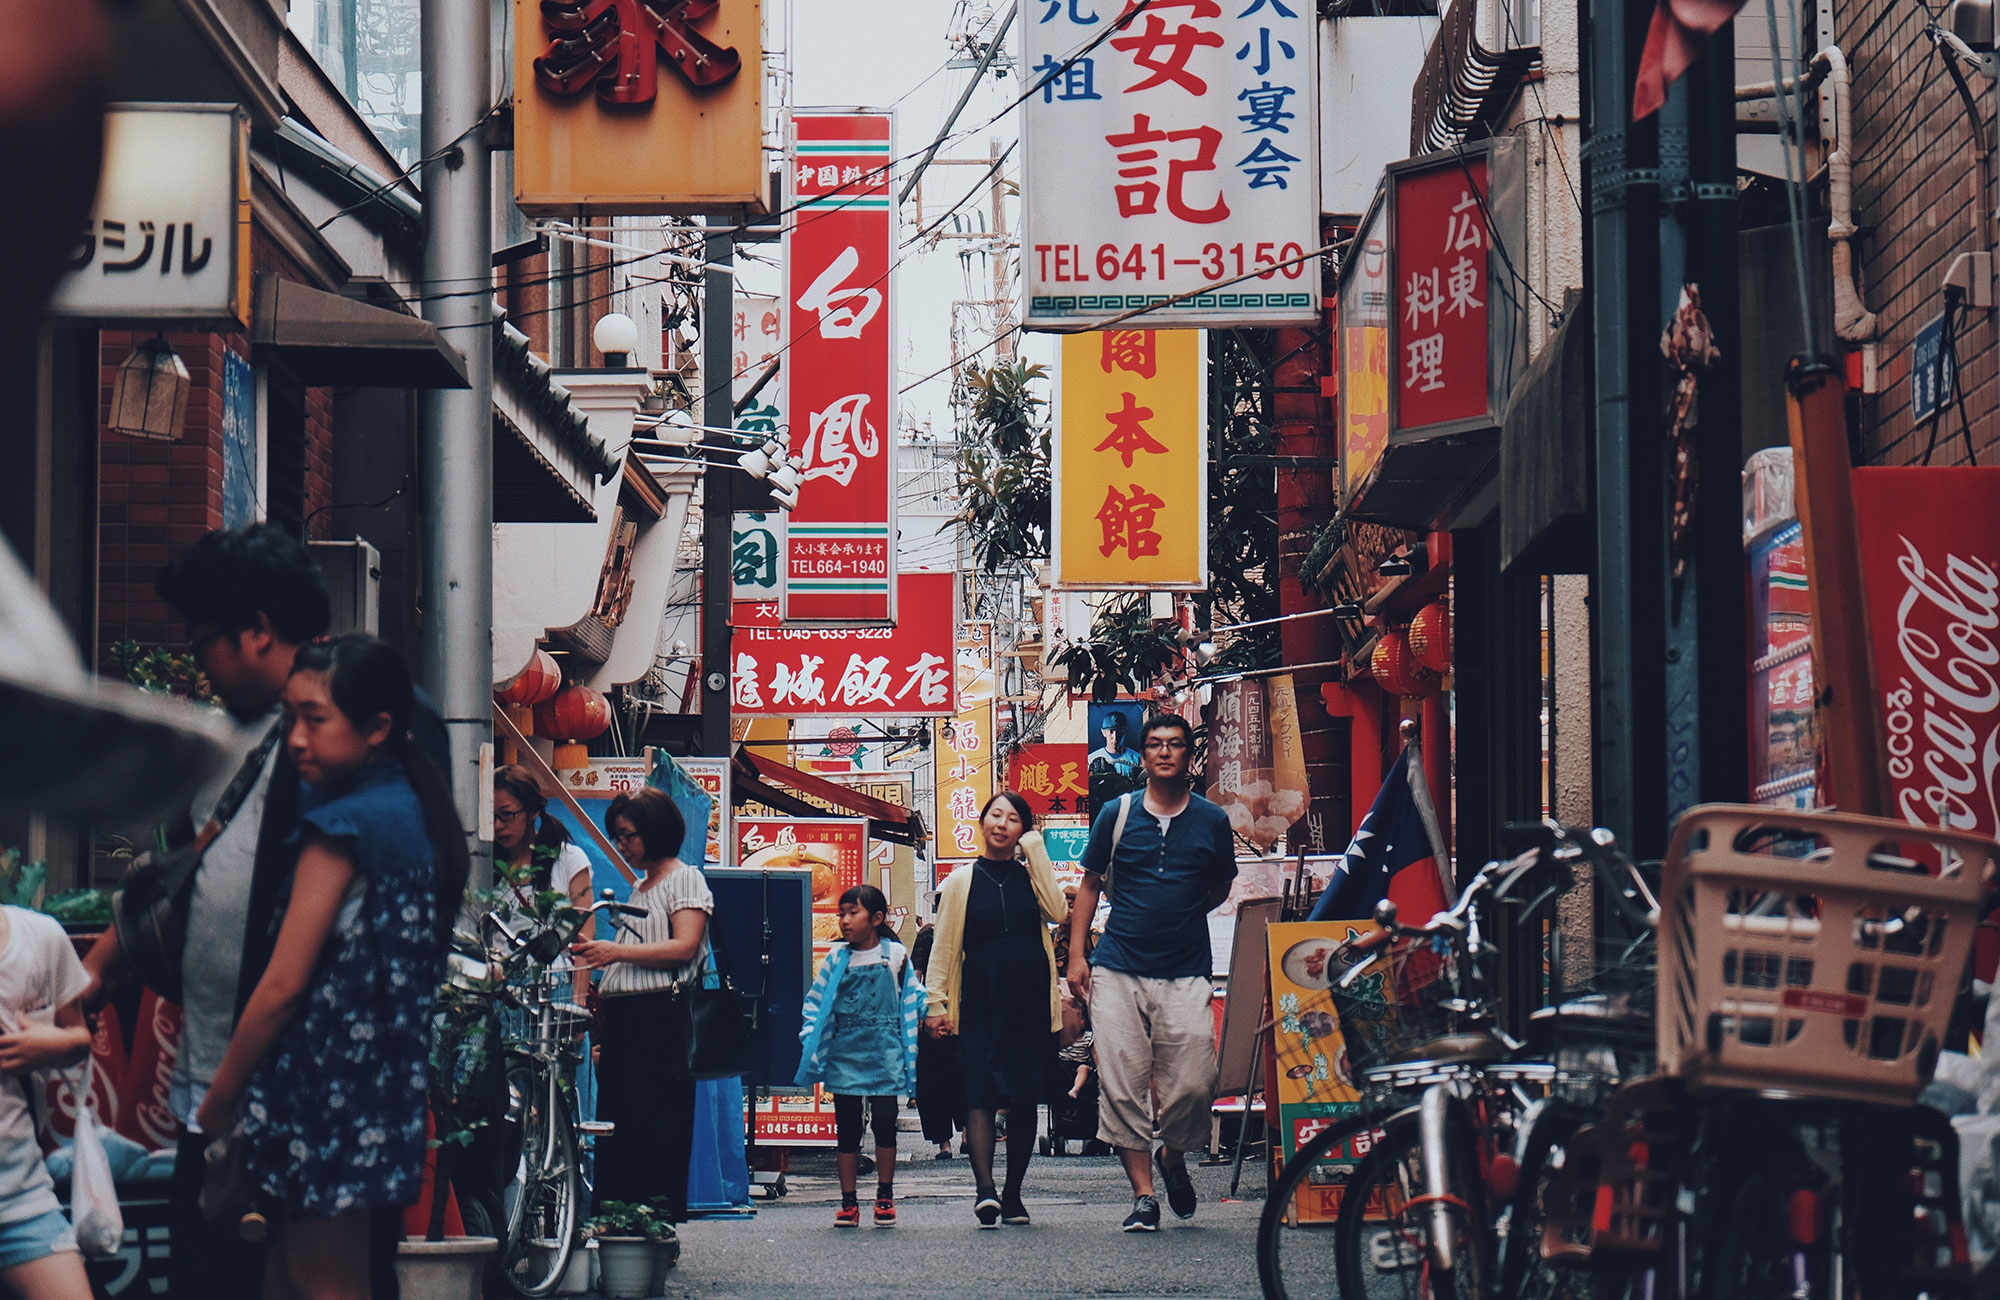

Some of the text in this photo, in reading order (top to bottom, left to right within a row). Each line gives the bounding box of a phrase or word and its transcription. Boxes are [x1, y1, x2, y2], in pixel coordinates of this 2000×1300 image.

[796, 164, 886, 188] 中国料理
[1444, 190, 1484, 319] 広東
[796, 245, 883, 487] 白鳳
[1404, 266, 1446, 393] 料理
[794, 542, 884, 556] 大小宴会承ります
[1215, 688, 1244, 796] 順海閣
[741, 825, 797, 851] 白鳳
